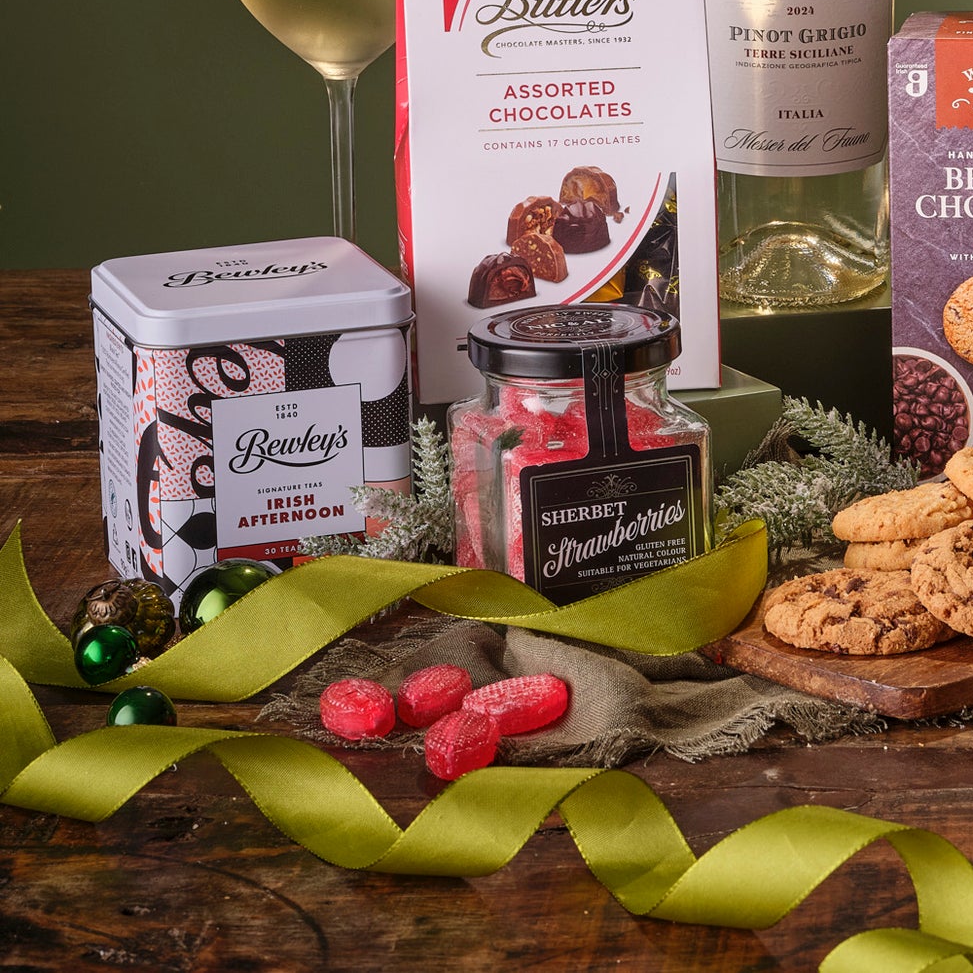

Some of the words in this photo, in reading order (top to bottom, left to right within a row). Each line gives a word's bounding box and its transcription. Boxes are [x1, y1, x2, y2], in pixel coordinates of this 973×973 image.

[786, 6, 815, 17] 2024
[728, 24, 793, 43] PINOT
[798, 23, 867, 44] GRIGIO
[495, 40, 543, 49] CHOCOLATE
[588, 37, 611, 45] SINCE
[743, 47, 786, 59] TERRE
[789, 45, 854, 59] SICILIANE
[735, 60, 787, 70] INDICAZIONE
[788, 60, 839, 70] GEOGRAFICA
[840, 57, 862, 66] TIPICA
[503, 80, 616, 100] ASSORTED
[488, 101, 632, 123] CHOCOLATES
[777, 109, 824, 120] ITALIA
[483, 140, 544, 151] CONTAINS
[548, 139, 558, 148] 17
[563, 135, 641, 147] CHOCOLATES
[723, 127, 785, 152] Messer
[788, 135, 819, 152] del
[822, 127, 871, 152] Fauno
[163, 261, 328, 288] Bewley's
[275, 404, 299, 412] ESTD
[276, 411, 299, 420] 1840
[228, 423, 349, 474] Bewley's
[257, 484, 301, 495] SIGNATURE
[302, 482, 323, 491] TEAS
[267, 494, 315, 510] IRISH
[237, 505, 344, 529] AFTERNOON
[541, 500, 627, 527] SHERBET
[543, 499, 686, 578] Strawberries
[635, 541, 665, 550] GLUTEN
[667, 537, 686, 546] FREE
[618, 550, 655, 563] NATURAL
[656, 547, 686, 557] COLOUR
[578, 565, 615, 577] SUITABLE
[617, 563, 632, 572] FOR
[633, 555, 687, 570] VEGETARIANS
